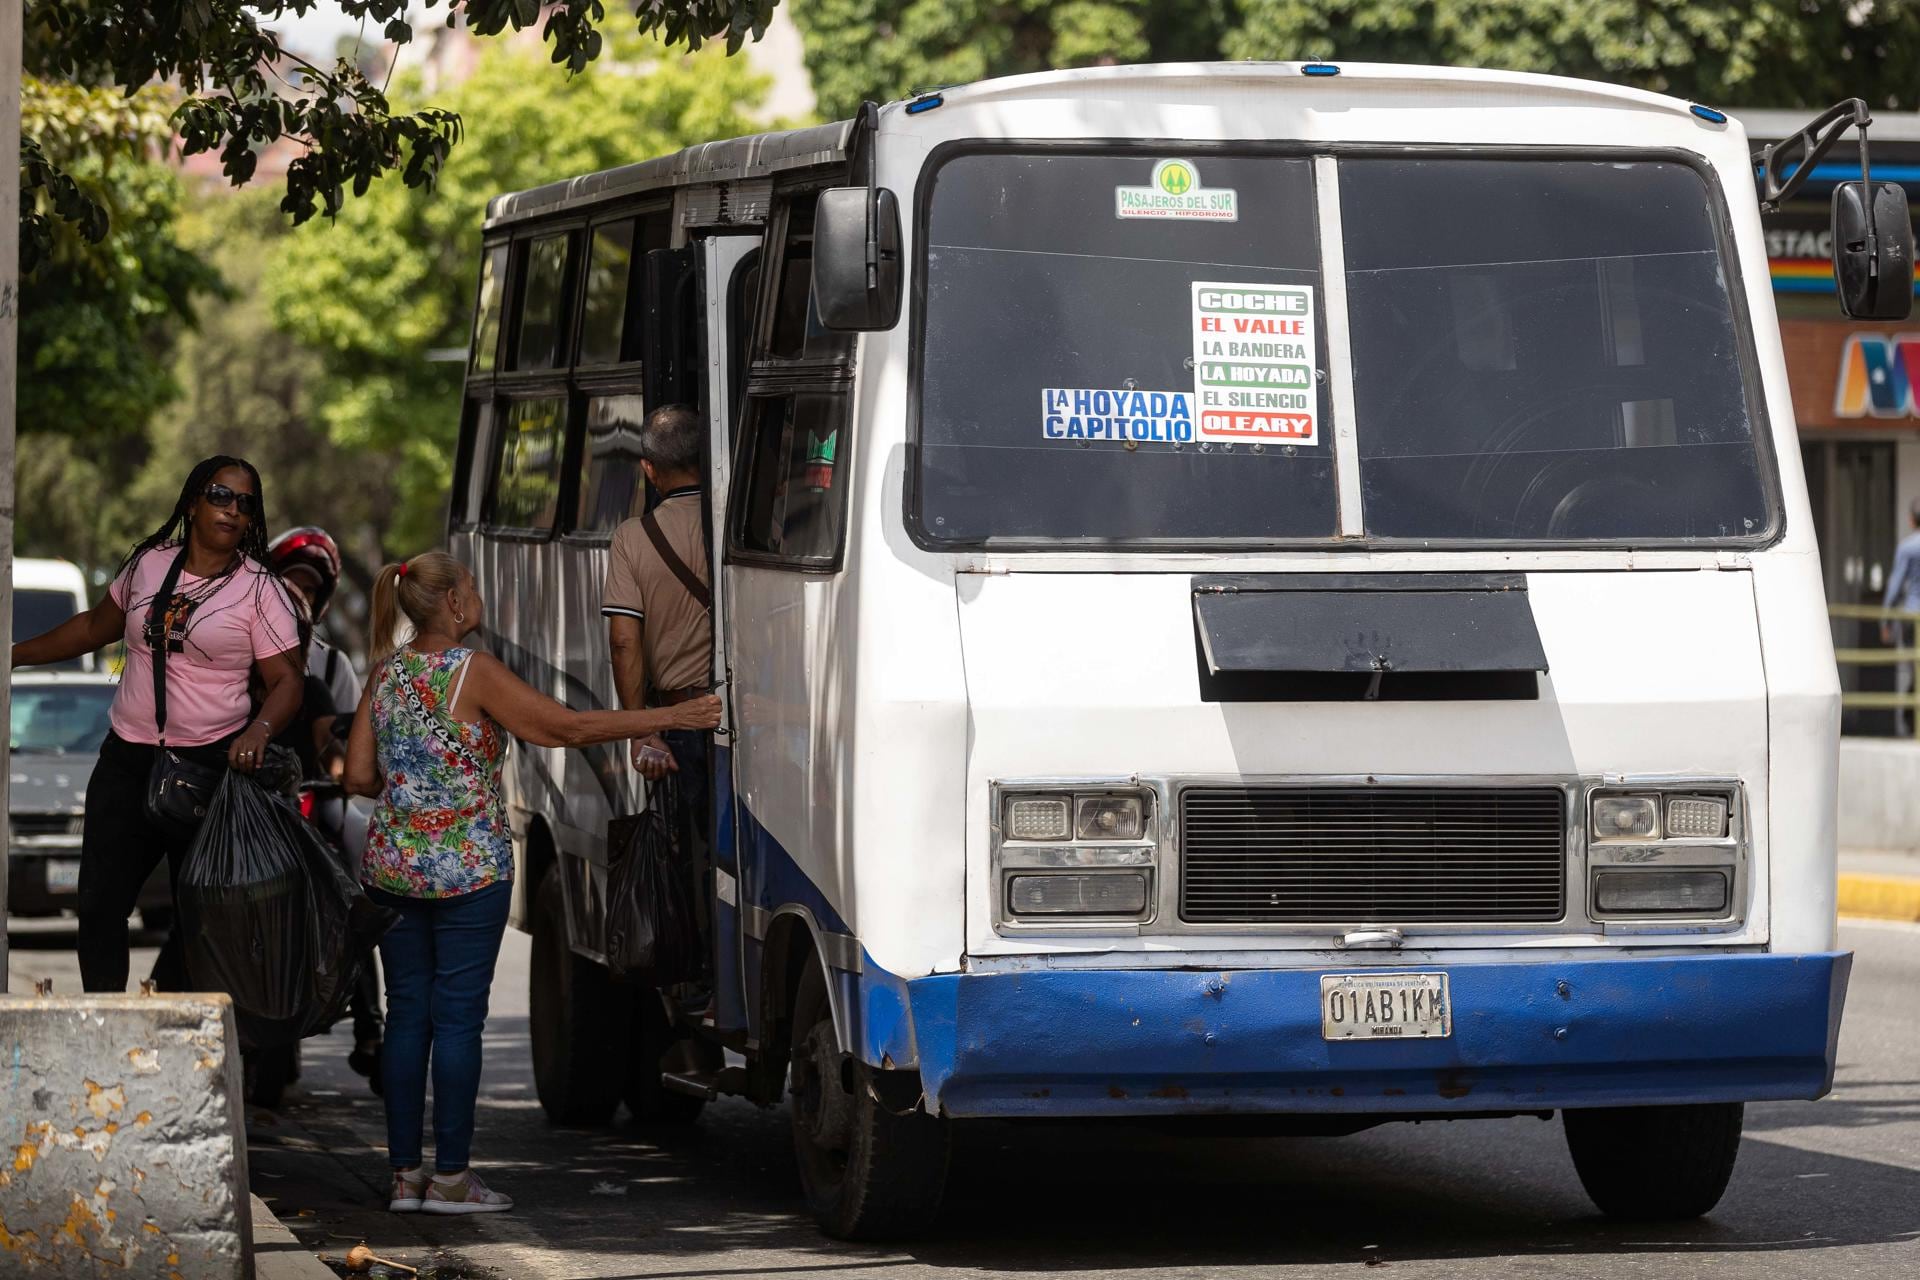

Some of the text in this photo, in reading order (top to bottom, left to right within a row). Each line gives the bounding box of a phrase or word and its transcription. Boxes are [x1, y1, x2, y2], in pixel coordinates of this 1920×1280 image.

[1121, 190, 1233, 211] PASAJEROS DEL SUR
[1175, 210, 1233, 218] HIPODROMO
[1199, 293, 1306, 311] COCHE
[1200, 317, 1305, 336] EL VALLE
[1202, 340, 1306, 359] LA BANDERA
[1202, 365, 1308, 384] LA HOYADA
[1047, 389, 1190, 419] LA HOYADA
[1203, 391, 1307, 409] EL SILENCIO
[1046, 416, 1192, 441] CAPITOLIO
[1202, 415, 1310, 433] OLEARY
[1330, 988, 1442, 1024] 01AB1KM
[1371, 1025, 1403, 1036] MIRANDA
